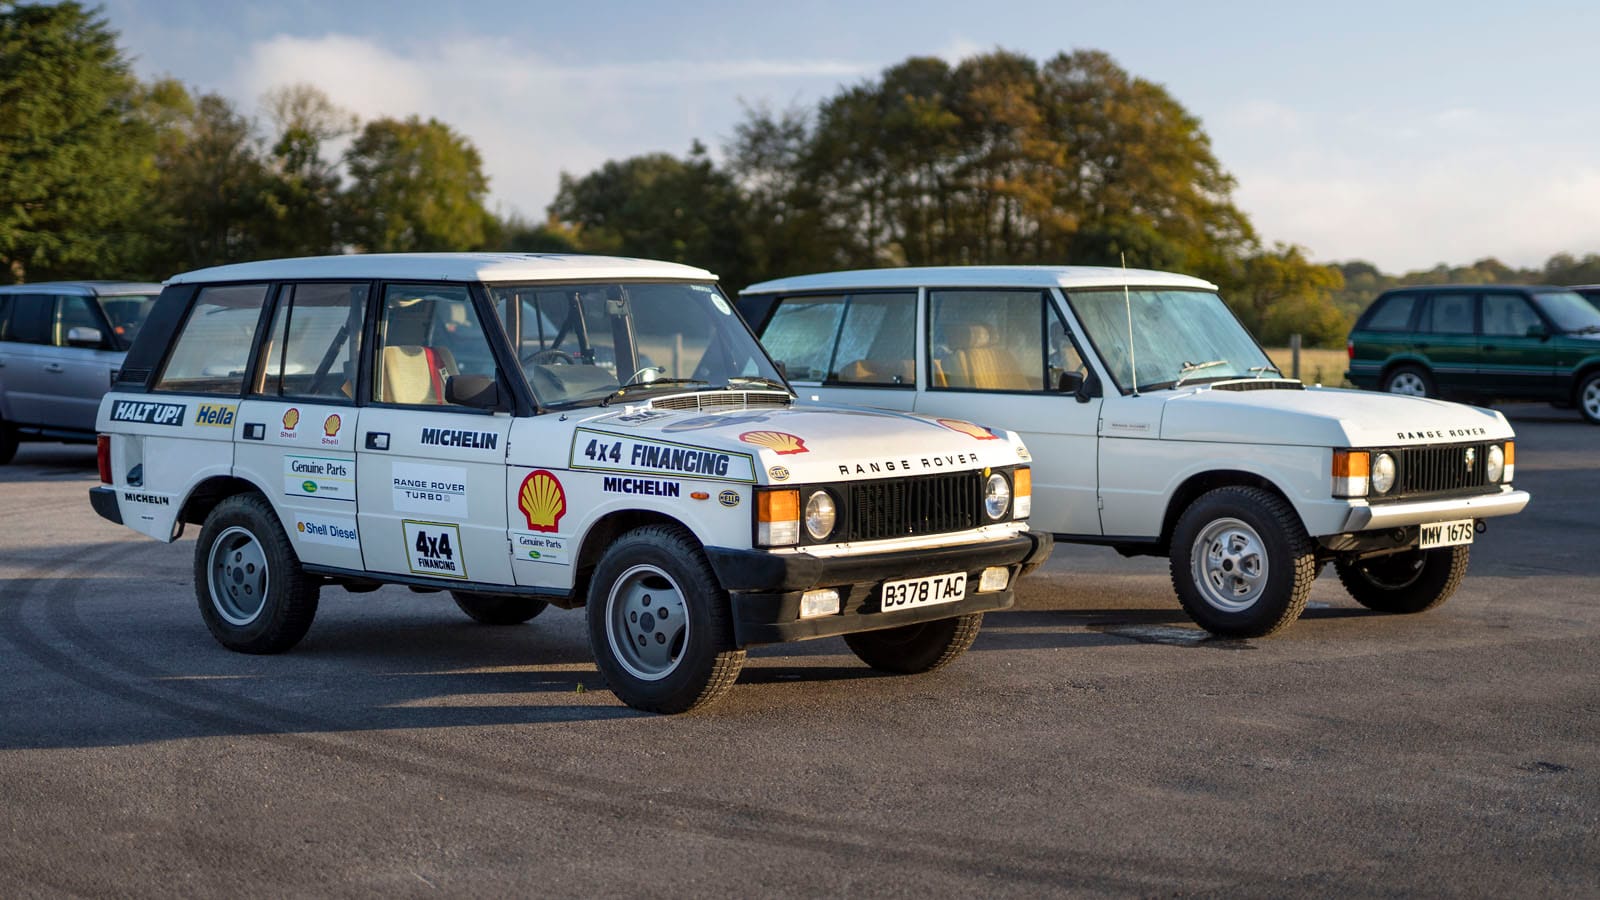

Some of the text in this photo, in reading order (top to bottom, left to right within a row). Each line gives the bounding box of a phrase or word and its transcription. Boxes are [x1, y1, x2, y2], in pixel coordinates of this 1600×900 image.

[196, 405, 234, 425] Hella
[280, 431, 297, 439] Shell
[321, 437, 339, 446] Shell
[421, 428, 498, 450] MICHELIN
[1396, 427, 1487, 440] RANGE ROVER
[584, 438, 730, 477] 4x4 FINANCING
[838, 452, 980, 476] RANGE ROVER
[291, 459, 347, 477] Genuine Parts
[393, 478, 465, 492] RANGE ROVER
[603, 476, 680, 498] MICHELIN
[124, 492, 170, 506] MICHELIN
[405, 490, 443, 502] TURBO
[305, 521, 357, 541] Shell Diesel
[1421, 522, 1473, 545] WMV 167S
[415, 530, 453, 561] 4x4
[519, 535, 562, 549] Genuine Parts
[418, 557, 456, 572] FINANCING
[885, 575, 964, 608] B378 TAC
